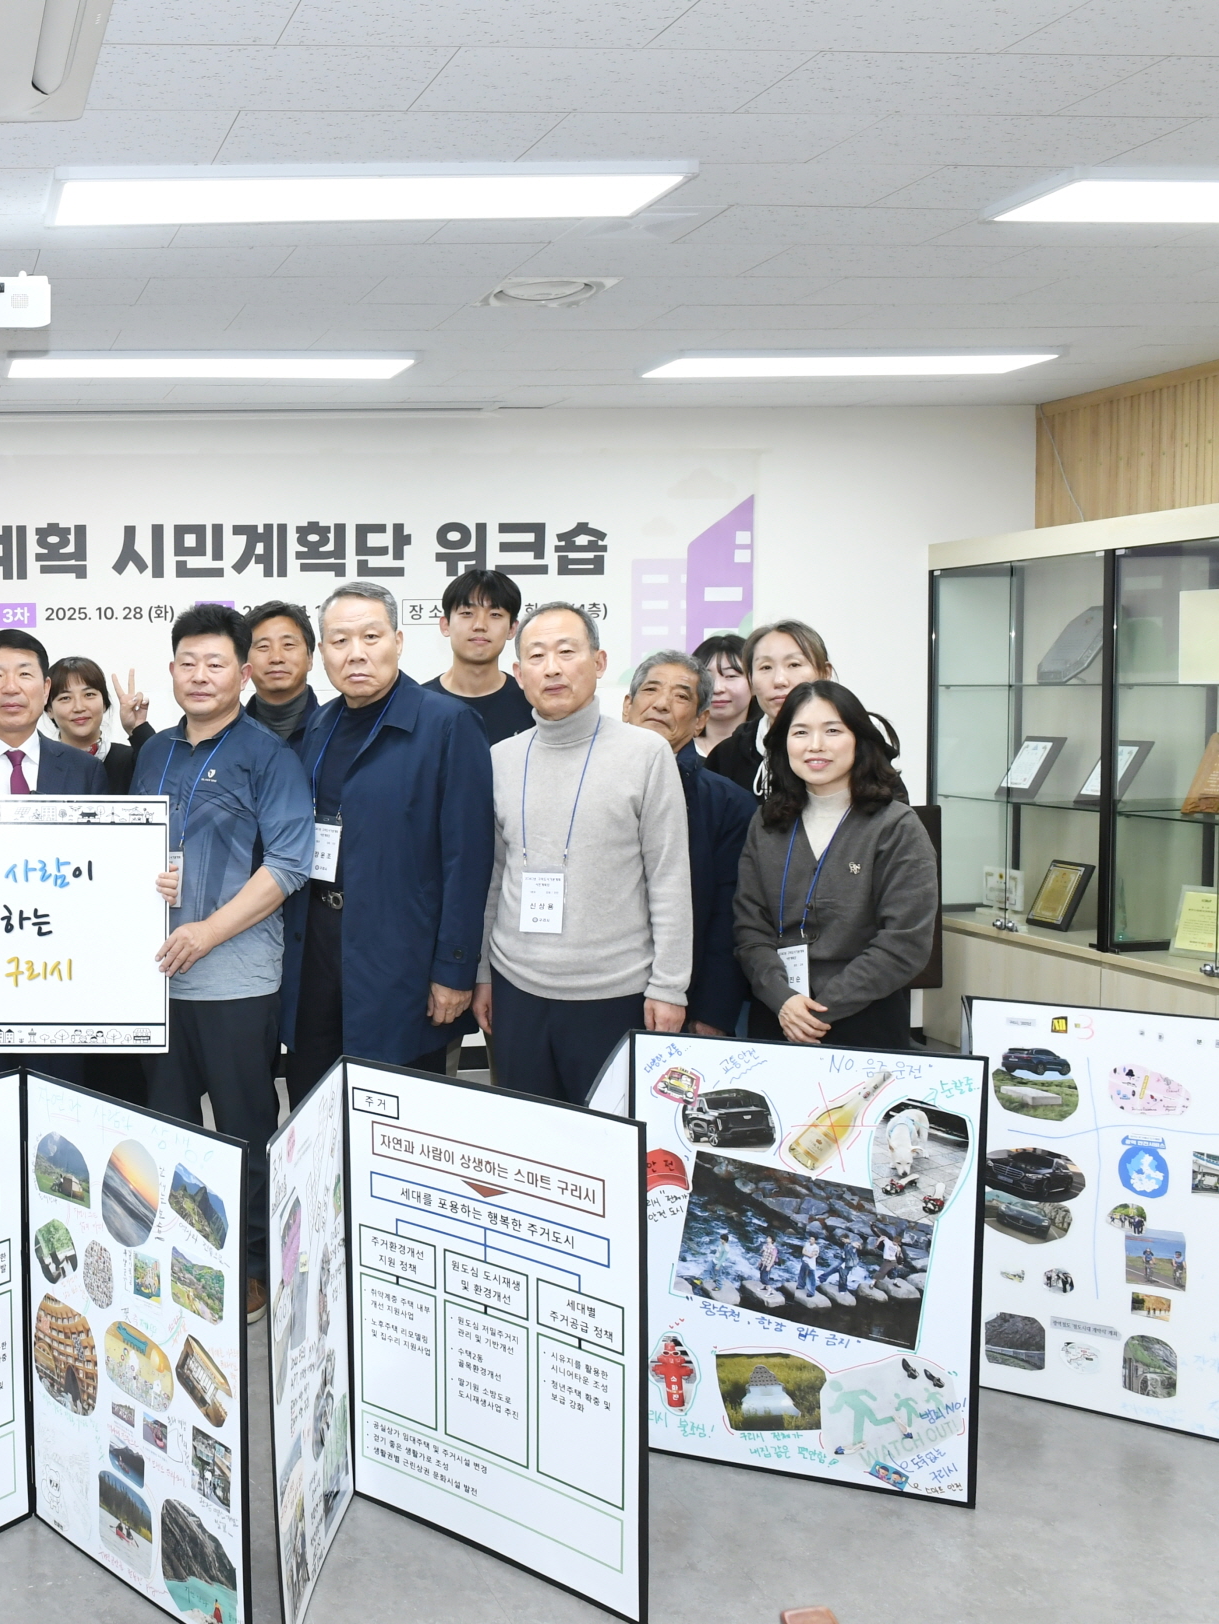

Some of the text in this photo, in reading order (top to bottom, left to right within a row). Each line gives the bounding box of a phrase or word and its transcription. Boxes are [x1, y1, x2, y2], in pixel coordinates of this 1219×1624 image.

[112, 522, 411, 579] 시민계획단
[436, 521, 608, 577] 워크숍
[2, 607, 30, 623] 3차
[45, 607, 92, 621] 2025.
[96, 607, 119, 621] 10.
[123, 606, 143, 620] 28
[148, 605, 175, 624] (화)
[4, 857, 93, 888] 사람이
[5, 957, 72, 987] 구리시
[380, 1134, 595, 1204] 자연과 사람이 상생하는 스마트 구리시
[400, 1188, 574, 1249] 세대를 포용하는 행복한 주거도시
[371, 1236, 424, 1260] 주거환경개선
[378, 1254, 417, 1274] 지원 정책
[452, 1260, 520, 1292] 원도심 도시재생
[461, 1279, 510, 1305] 및 환경개선
[566, 1300, 596, 1318] 세대별
[550, 1310, 614, 1343] 주거공급 정책
[859, 1420, 958, 1465] WATCH OUT!
